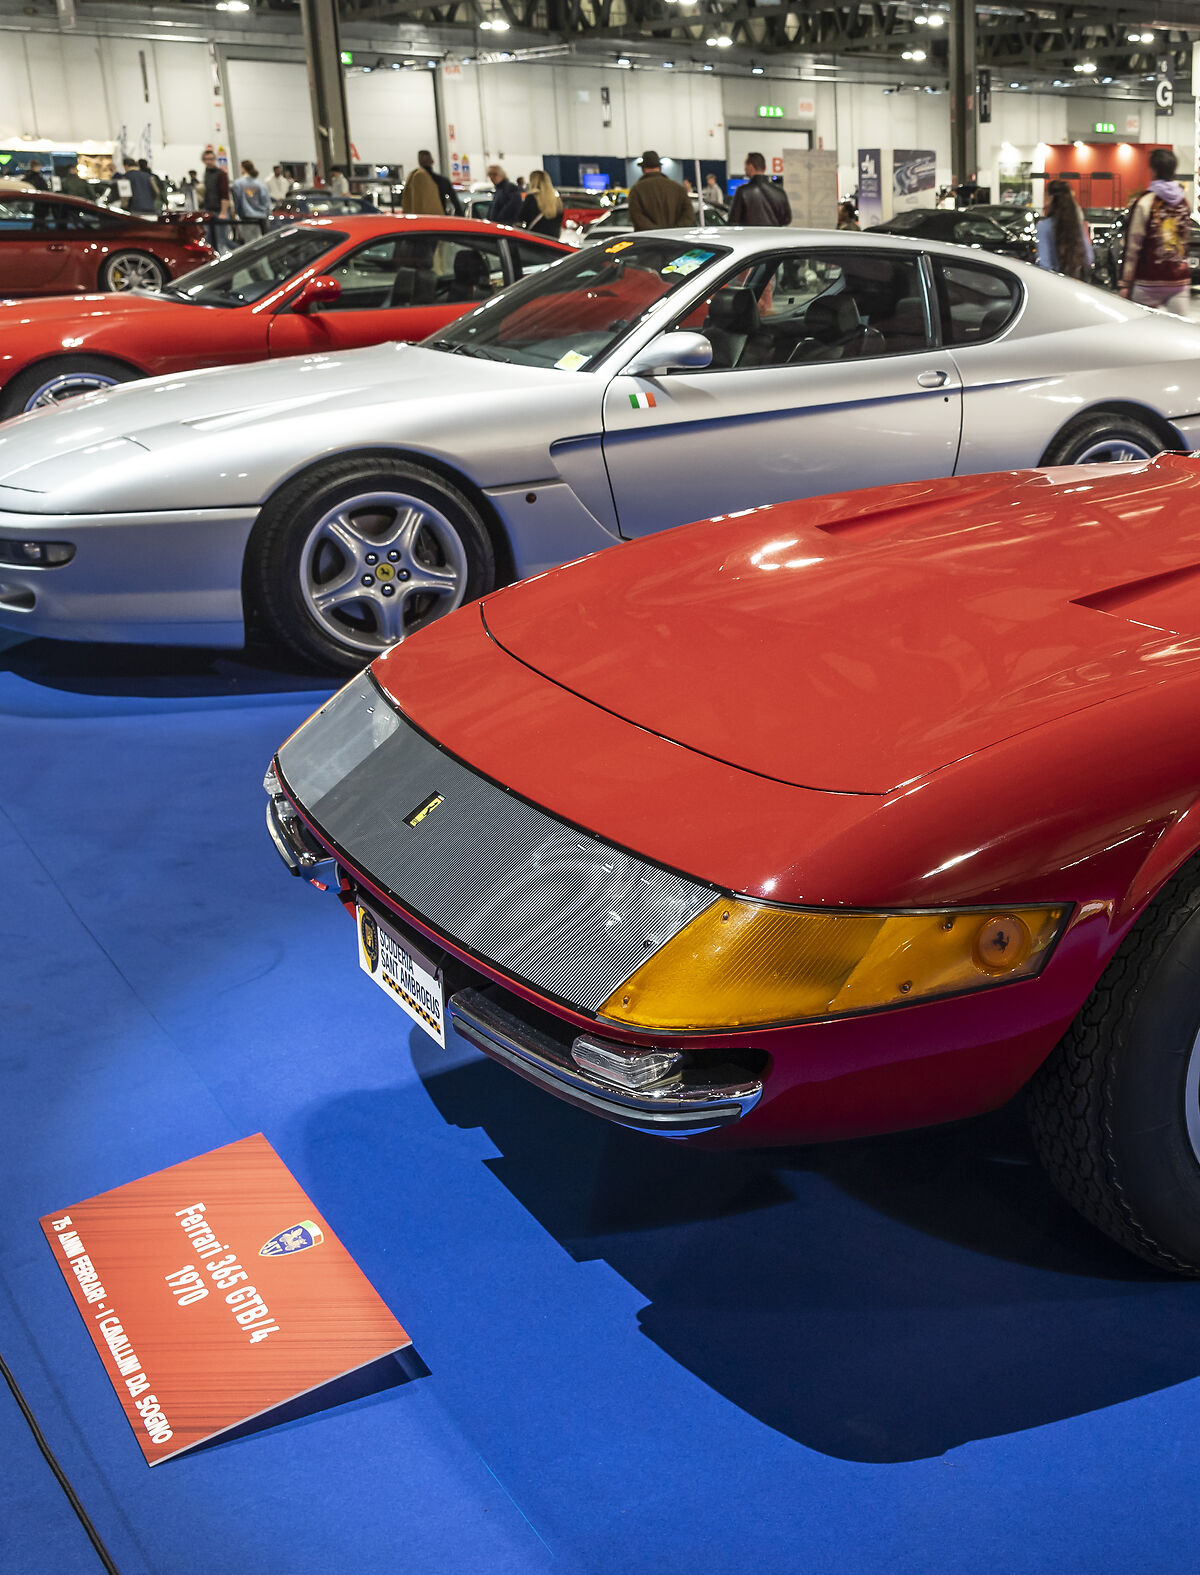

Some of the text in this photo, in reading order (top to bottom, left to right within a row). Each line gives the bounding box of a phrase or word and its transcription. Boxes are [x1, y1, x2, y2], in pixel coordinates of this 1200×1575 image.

[1156, 80, 1173, 107] G
[772, 157, 784, 173] B
[379, 929, 414, 975] SCUDERIA
[381, 949, 440, 1019] SANT AMBROEUS
[52, 1216, 72, 1231] 75
[57, 1231, 86, 1259] ANNI
[70, 1254, 107, 1304] FERRARI
[165, 1265, 209, 1306] 1970
[175, 1202, 280, 1344] Ferrari 365 GTB/4
[99, 1316, 142, 1376] CAVALLINI
[125, 1372, 150, 1398] DA
[134, 1394, 174, 1444] SOGNO
